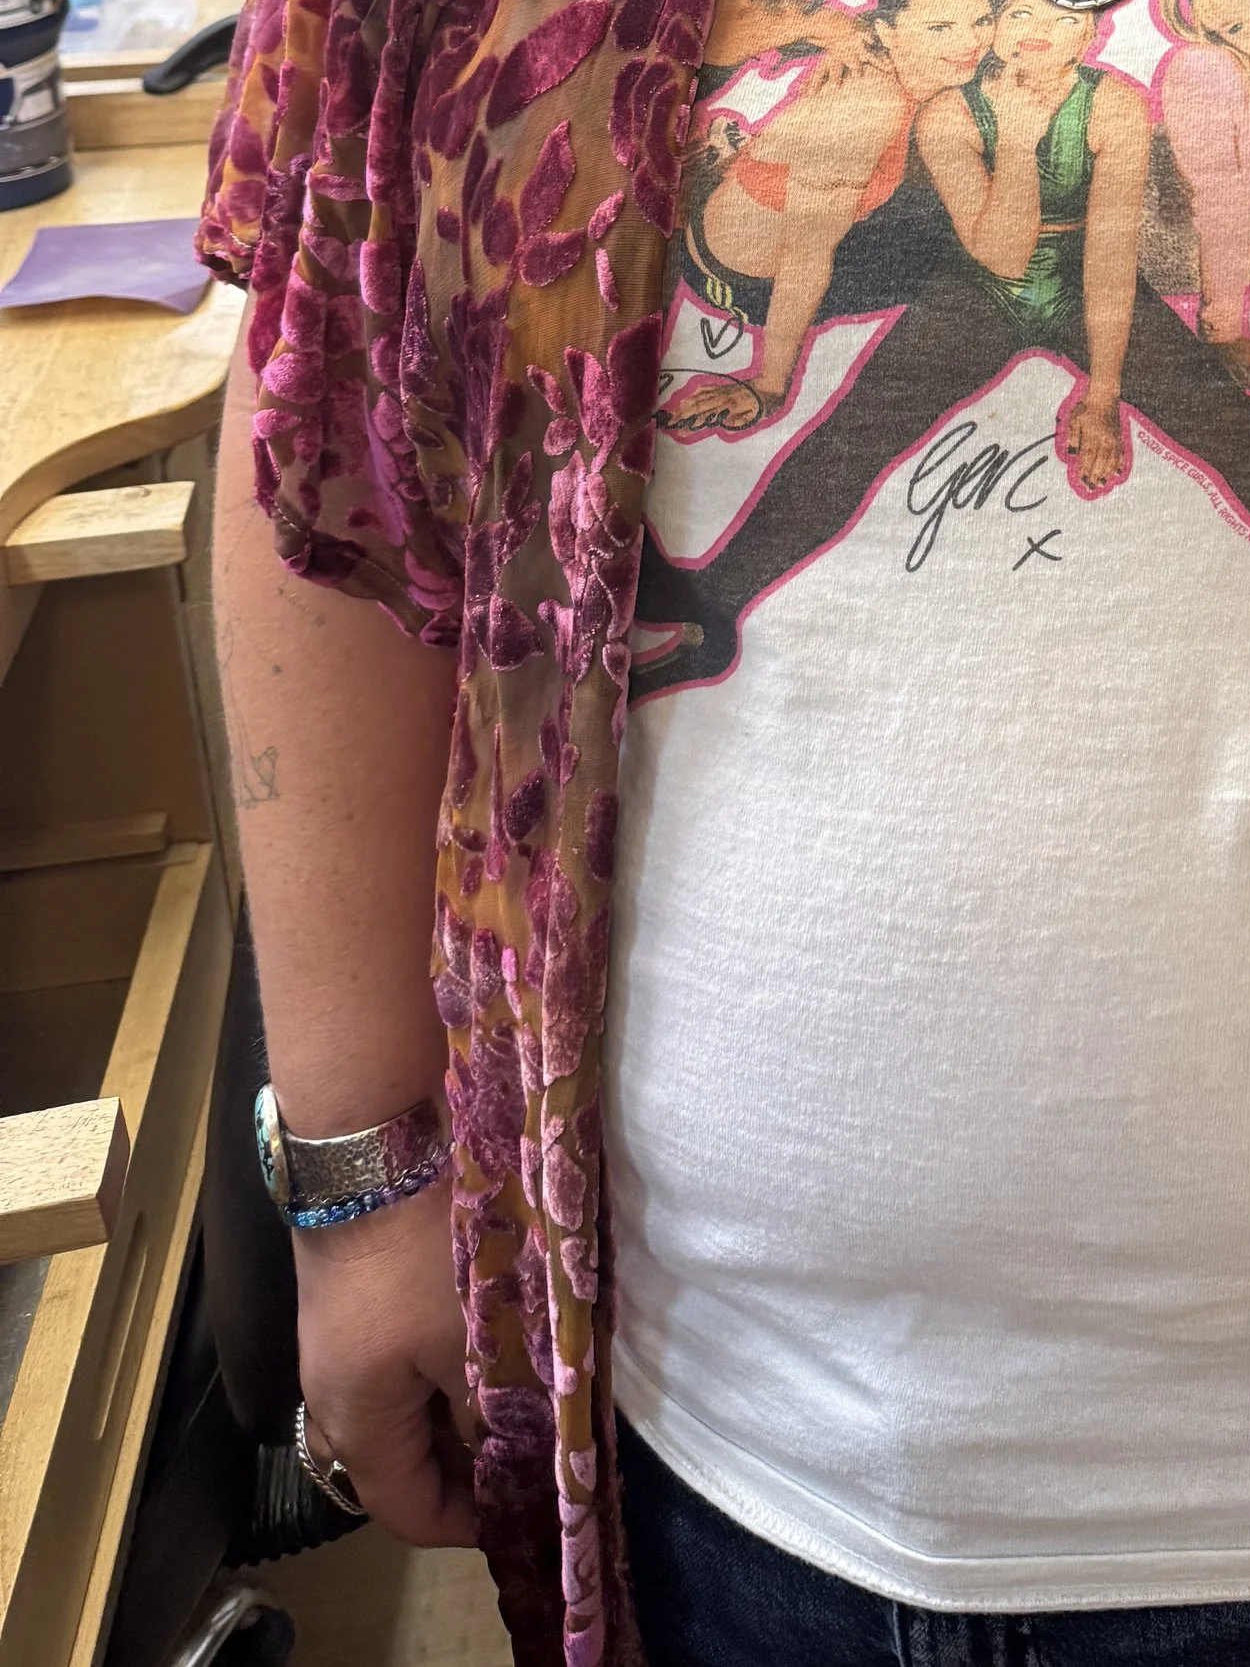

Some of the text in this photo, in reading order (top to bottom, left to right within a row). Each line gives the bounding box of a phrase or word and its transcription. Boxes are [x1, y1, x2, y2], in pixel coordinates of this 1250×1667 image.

[1163, 451, 1188, 472] SPICE
[1208, 492, 1222, 509] ALL
[1217, 508, 1249, 536] RIGHTS
